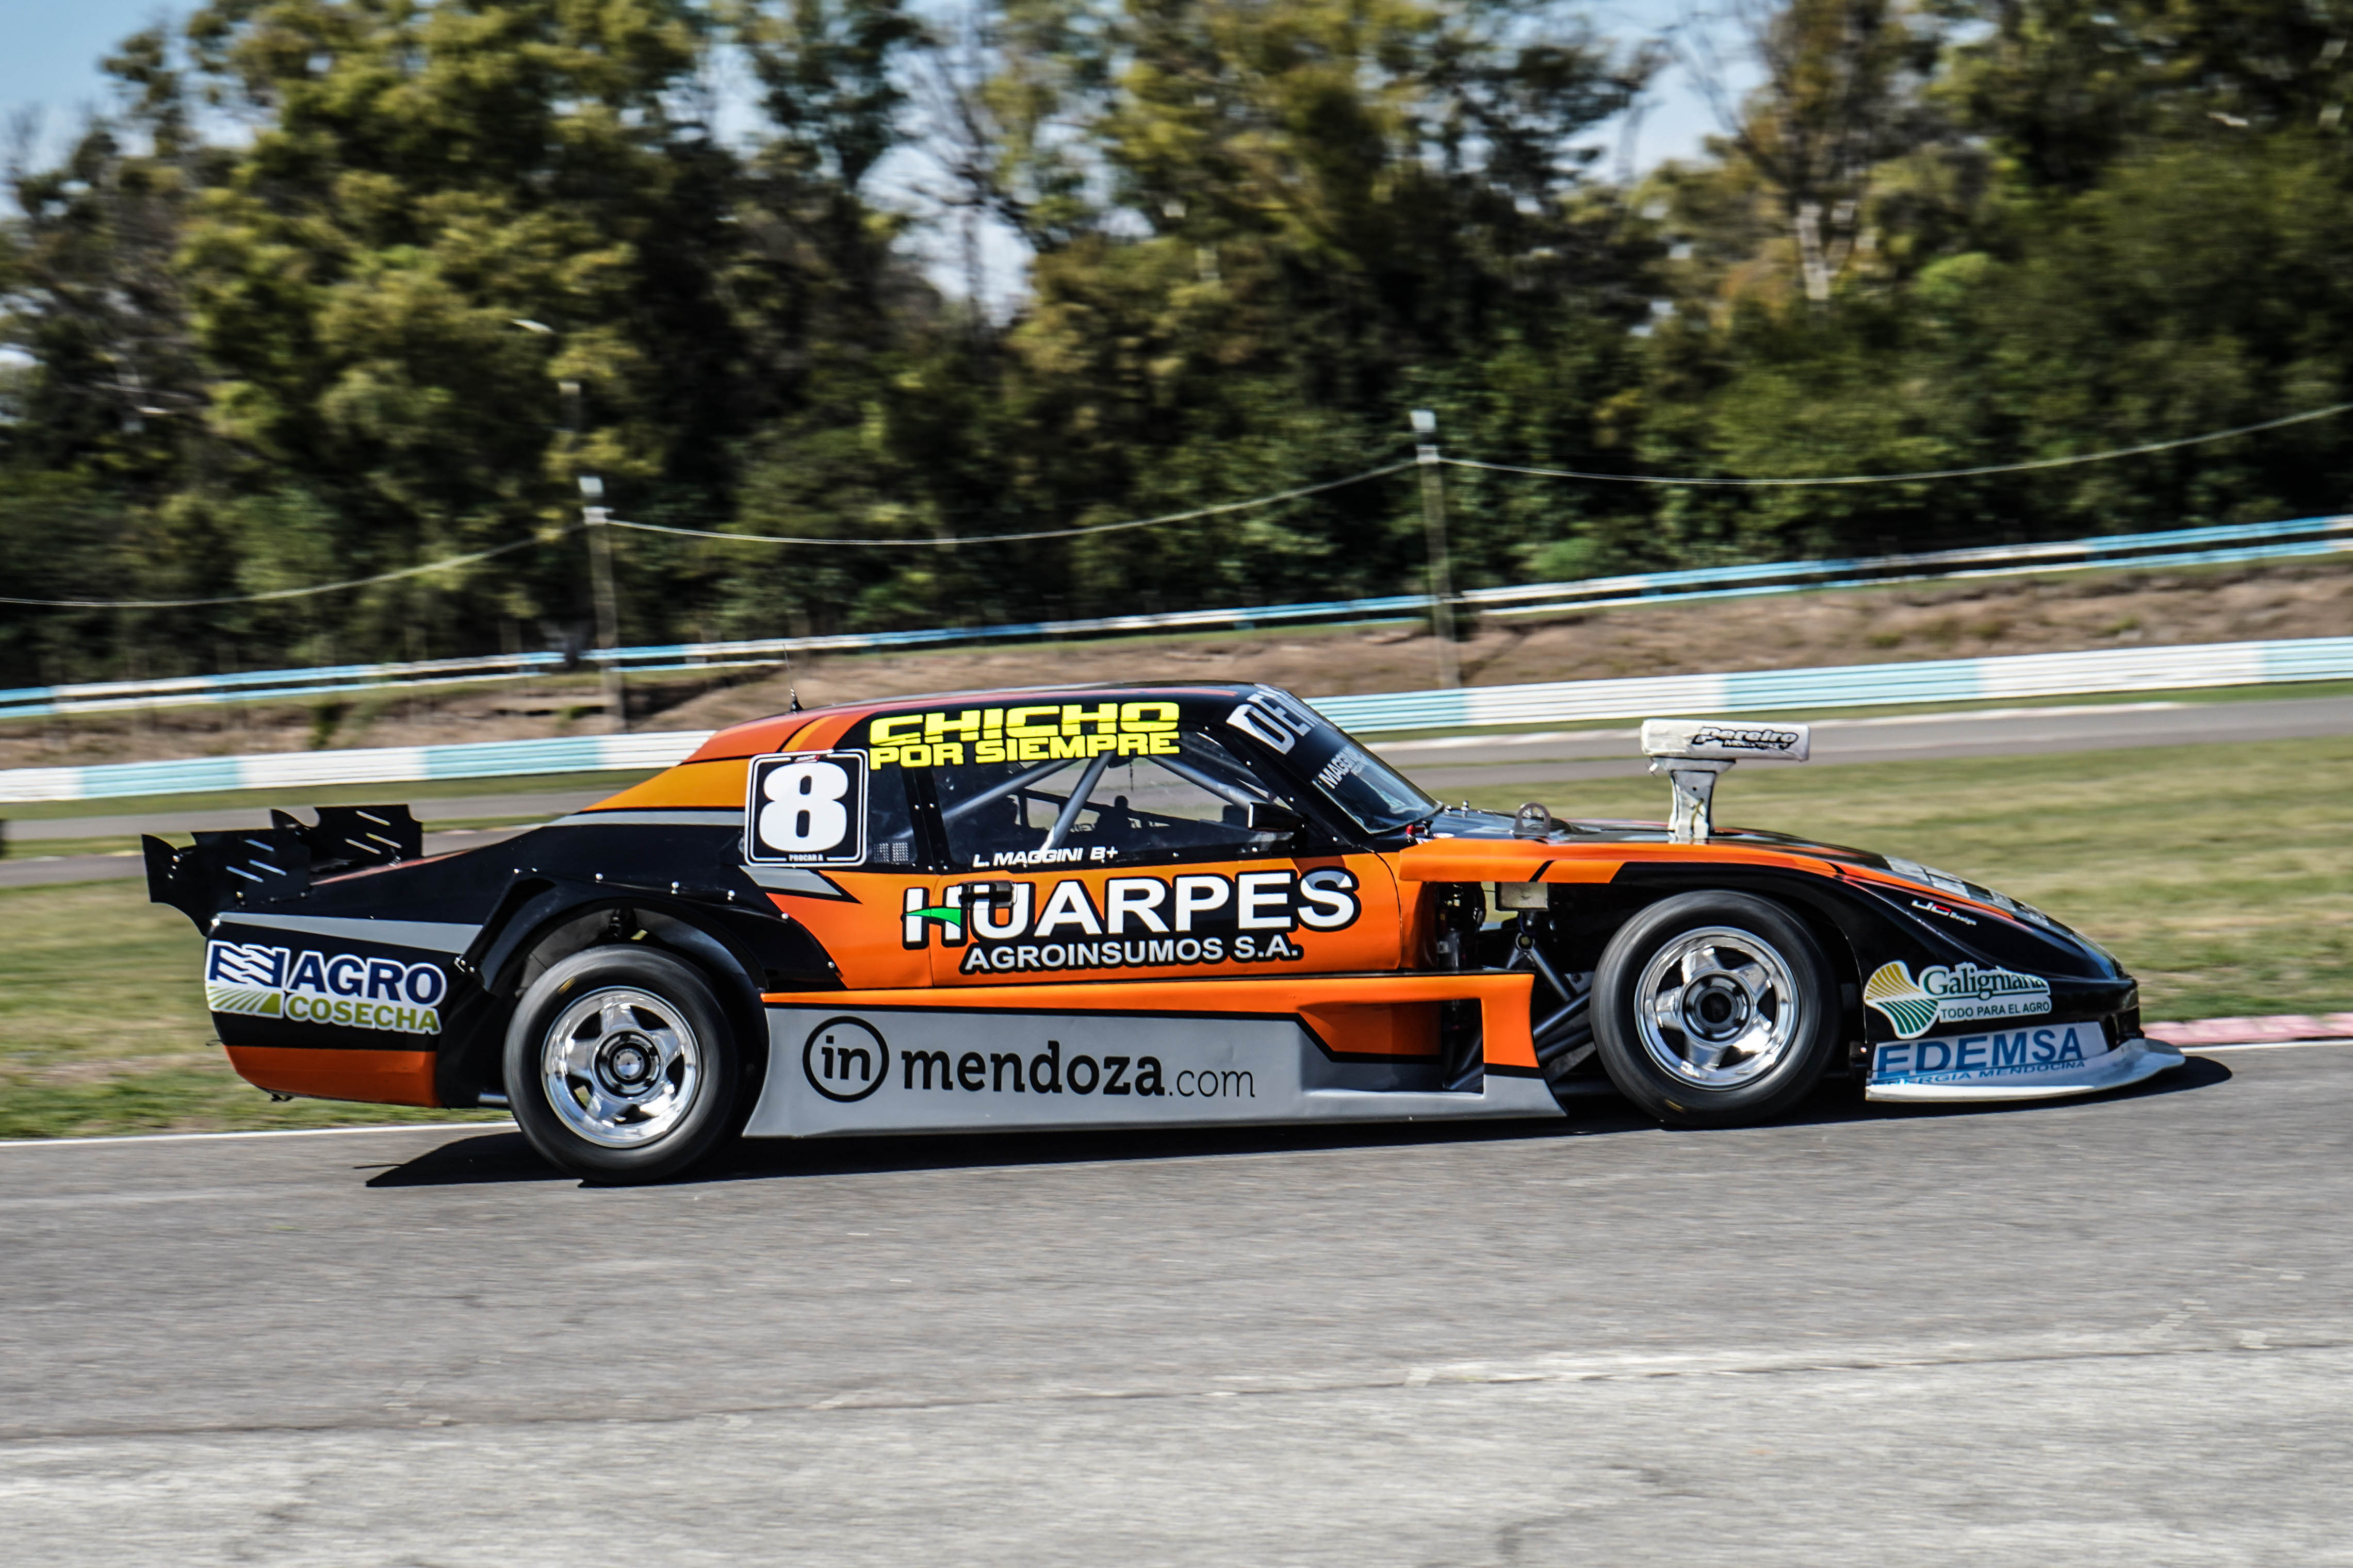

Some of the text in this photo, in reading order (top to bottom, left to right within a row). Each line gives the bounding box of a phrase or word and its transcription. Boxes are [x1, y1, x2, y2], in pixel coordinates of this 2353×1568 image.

[870, 702, 1180, 747] CHICHO
[870, 731, 1180, 770] POR SIEMPRE
[759, 761, 849, 853] 8
[788, 853, 818, 862] PROCAR
[972, 846, 1119, 868] L. MAGGINI B+
[905, 871, 1355, 943] HUARPES
[965, 934, 1298, 970] AGROINSUMOS S.A.
[288, 995, 440, 1032] COSECHA
[1941, 1001, 2050, 1019] TODO PARA EL AGRO
[820, 1034, 1255, 1098] in mendoza.com
[1877, 1027, 2083, 1079] EDEMSA
[1871, 1060, 2085, 1085] RGIA MENDOCINA
